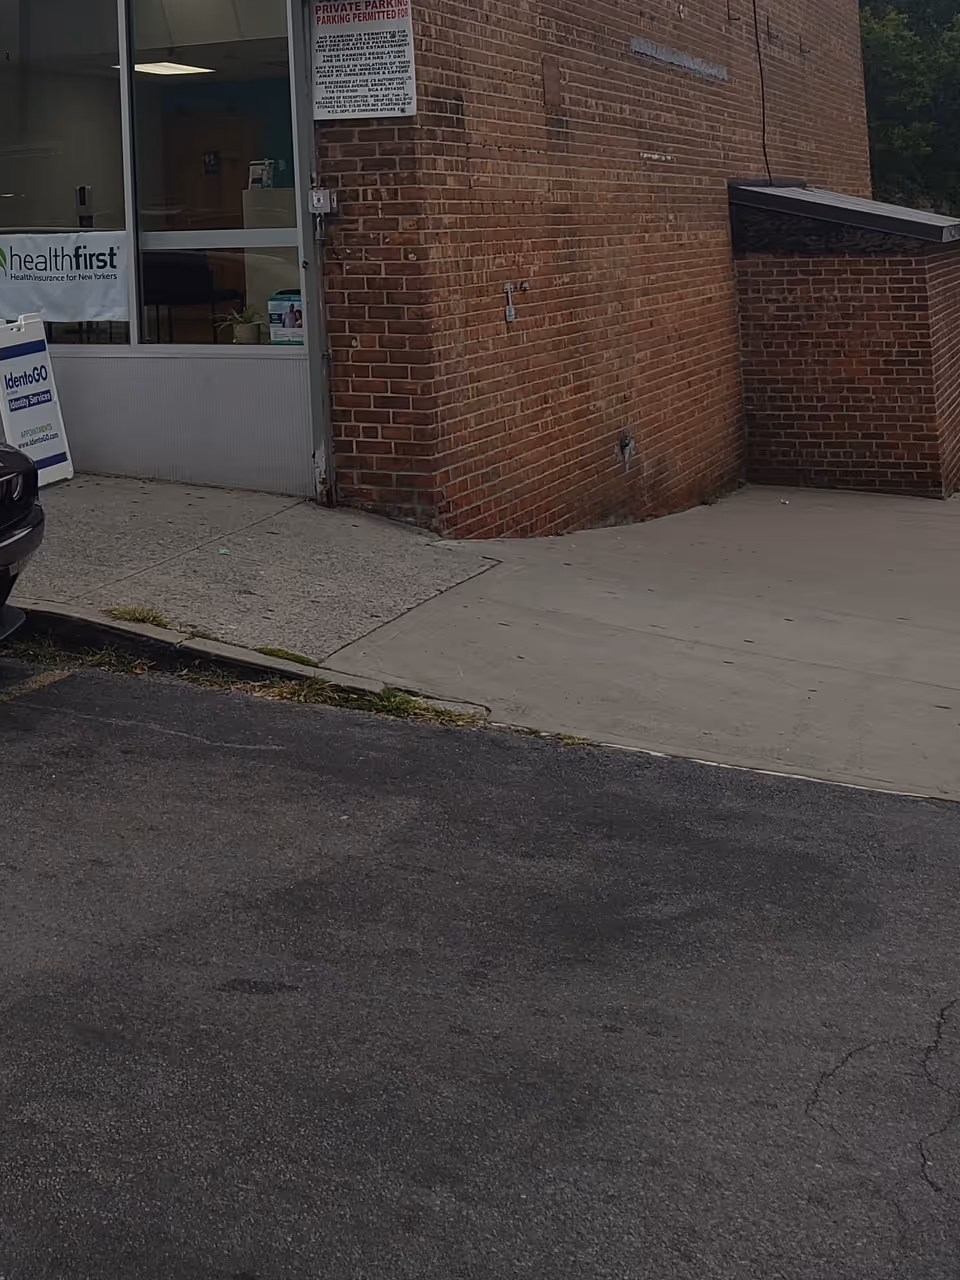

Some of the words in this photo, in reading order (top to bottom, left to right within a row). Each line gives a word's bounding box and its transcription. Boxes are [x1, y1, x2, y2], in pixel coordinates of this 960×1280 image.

[315, 2, 361, 15] PRIVATE
[317, 14, 351, 25] PARKING
[353, 9, 396, 22] PERMITTED
[397, 7, 408, 19] FOR
[10, 245, 117, 272] healthfirst
[10, 273, 34, 281] Health
[66, 273, 77, 281] for
[78, 273, 93, 281] New
[4, 364, 48, 390] IdentoGO
[9, 397, 29, 410] Identity
[29, 392, 50, 405] Services
